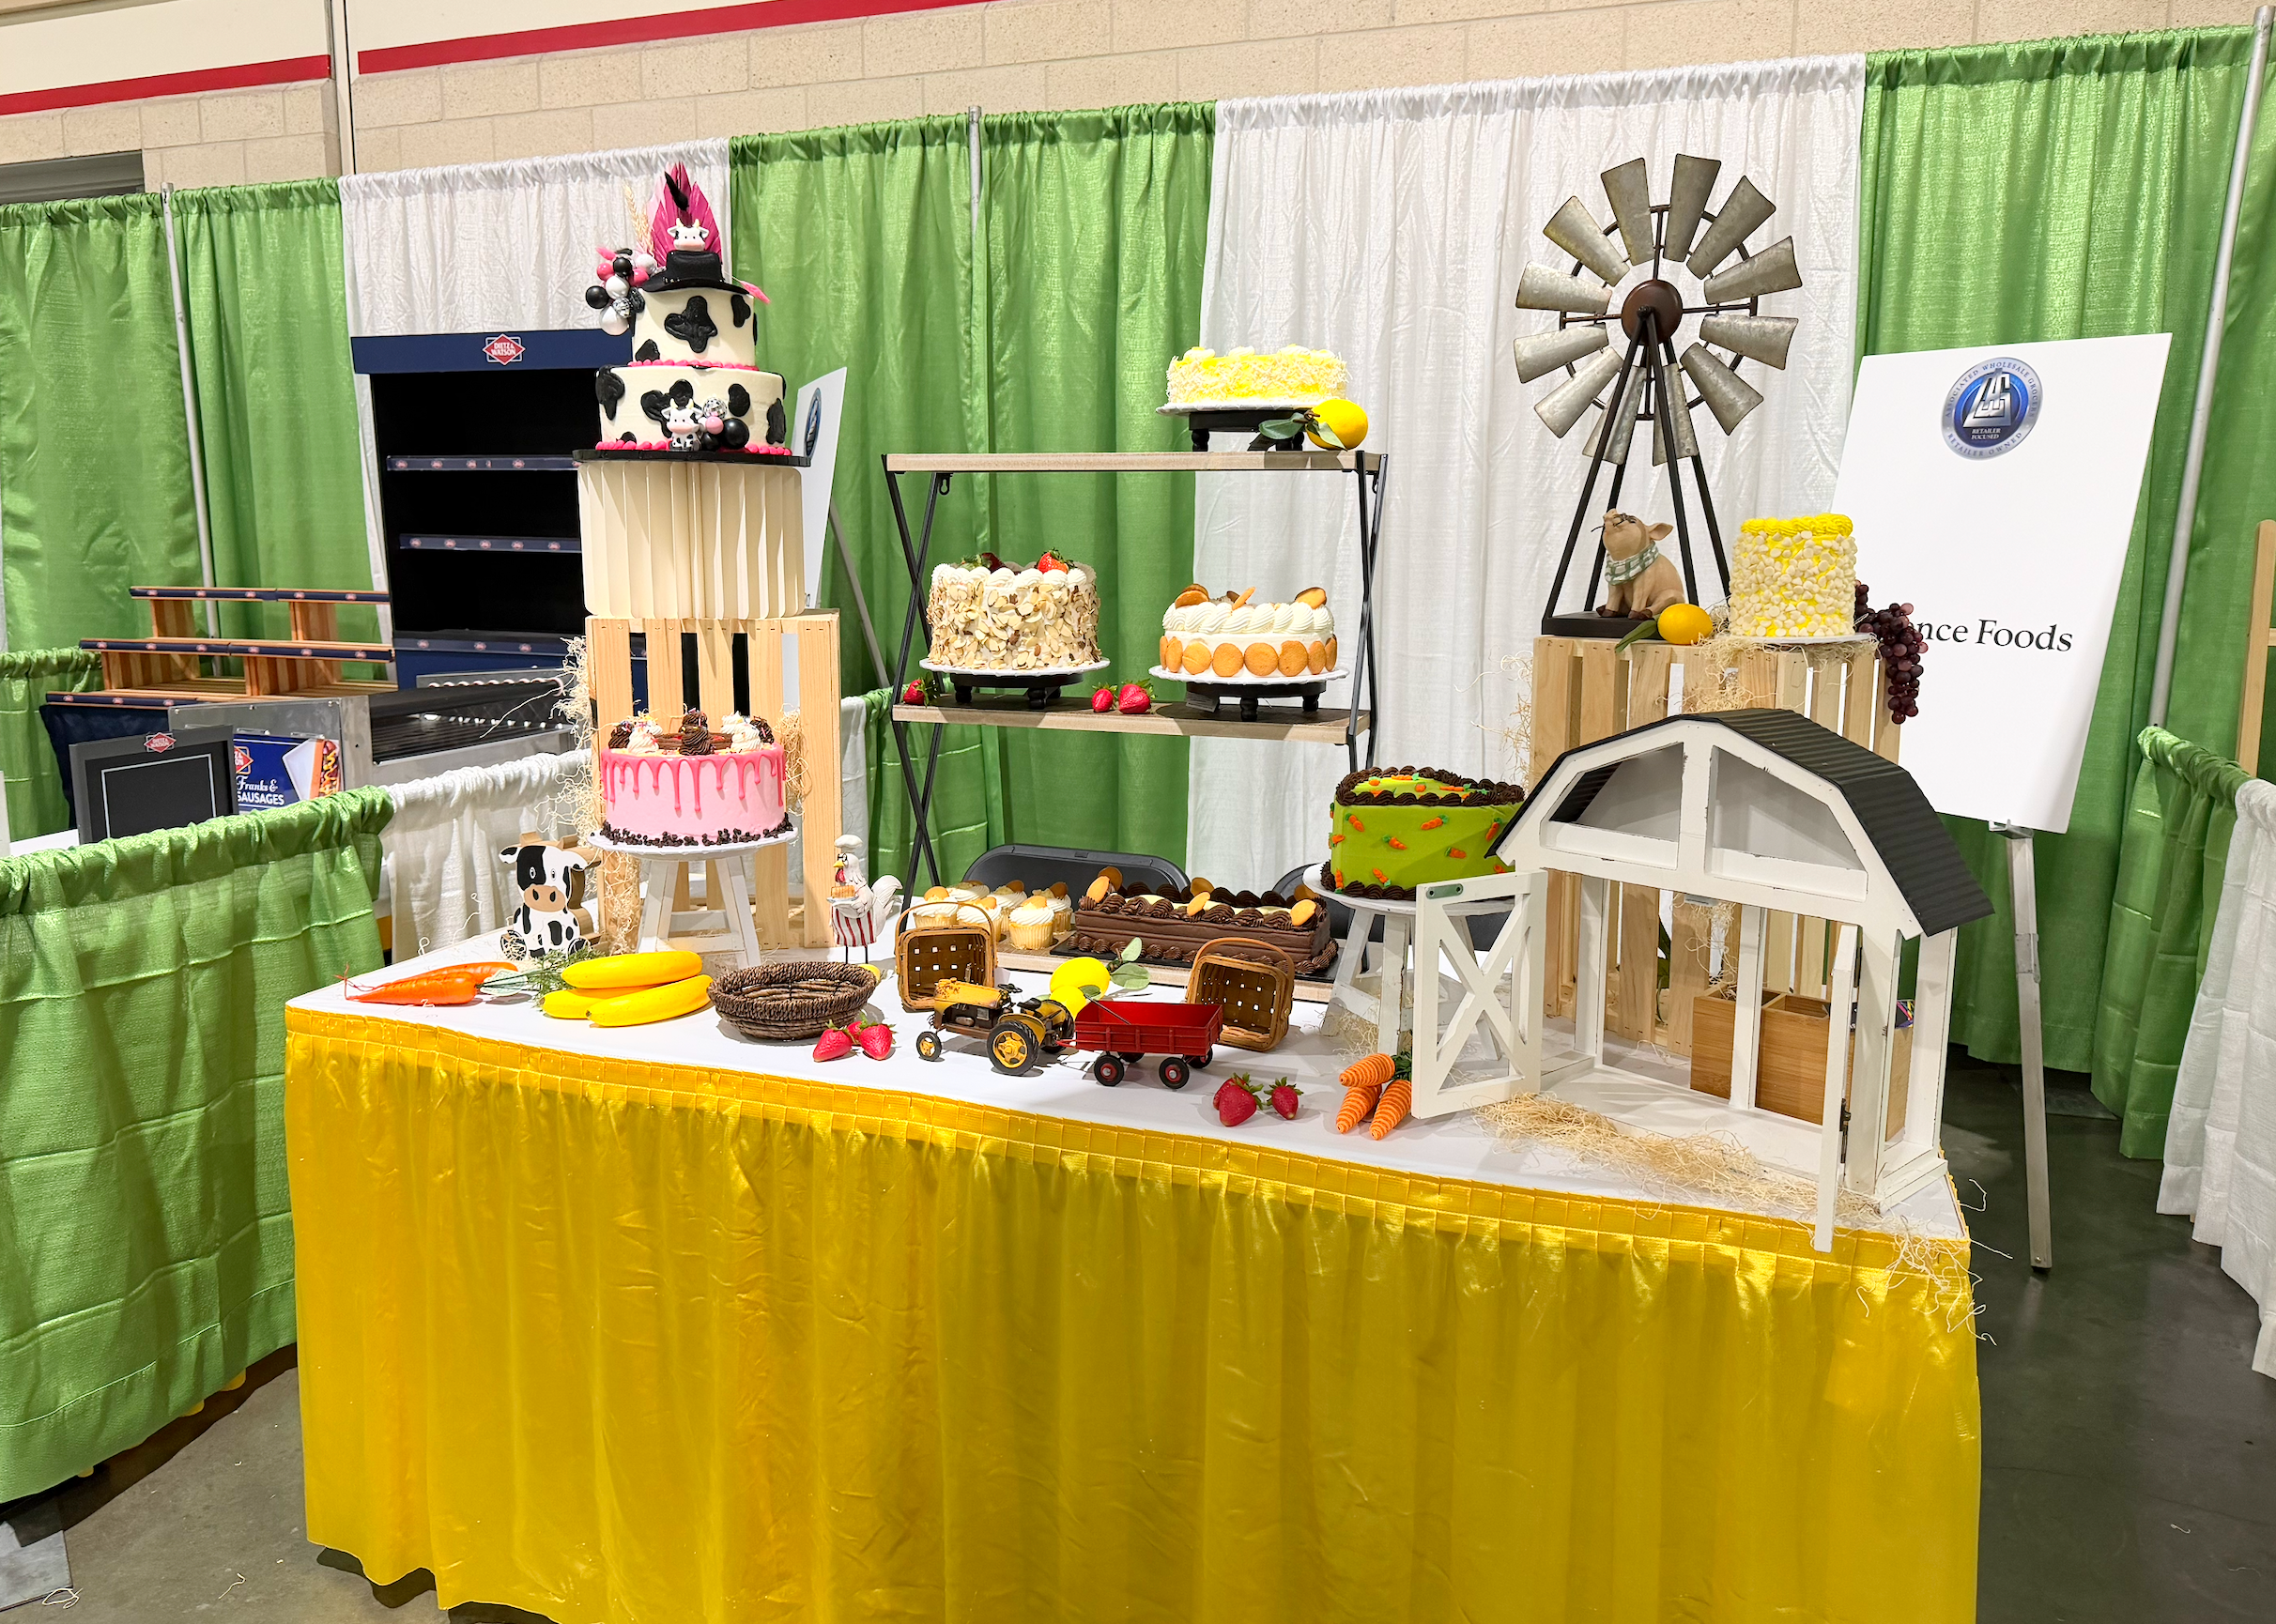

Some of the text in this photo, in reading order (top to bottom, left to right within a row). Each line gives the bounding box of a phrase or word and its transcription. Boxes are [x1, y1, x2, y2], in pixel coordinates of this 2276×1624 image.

[1945, 370, 1978, 418] ASSOCIATED
[1982, 361, 2030, 378] WHOLESALE
[1947, 432, 2022, 456] RETAILER OWNED
[1910, 619, 2073, 651] nce Foods
[236, 775, 278, 792] Franks &
